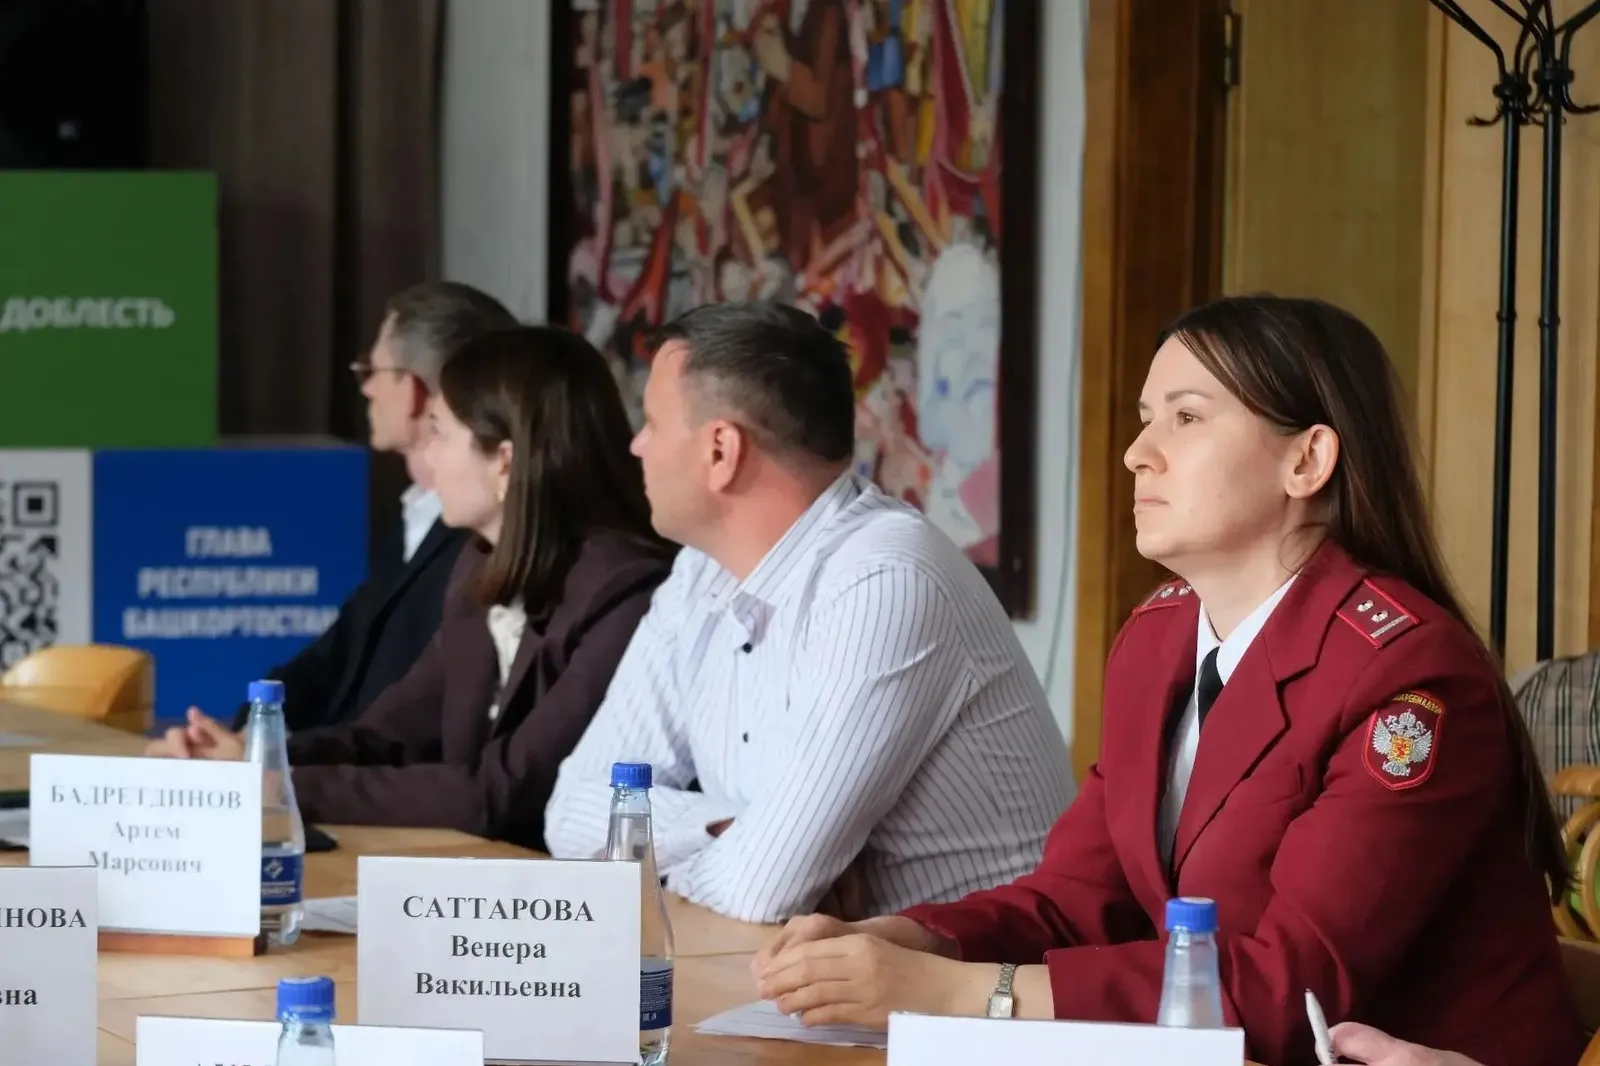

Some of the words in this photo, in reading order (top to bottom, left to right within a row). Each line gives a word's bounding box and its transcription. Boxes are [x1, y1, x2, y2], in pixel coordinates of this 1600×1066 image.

[186, 526, 271, 557] ГЛАВА
[137, 566, 319, 598] РЕСПУБЛИКИ
[51, 785, 242, 809] БАДРЕТДИНОВ
[111, 821, 181, 843] Артем
[88, 851, 202, 875] Марсович
[0, 907, 87, 928] НОВА
[402, 895, 595, 922] САТТАРОВА
[451, 935, 547, 964] Венера
[0, 988, 38, 1006] на
[415, 972, 582, 998] Вакильевна
